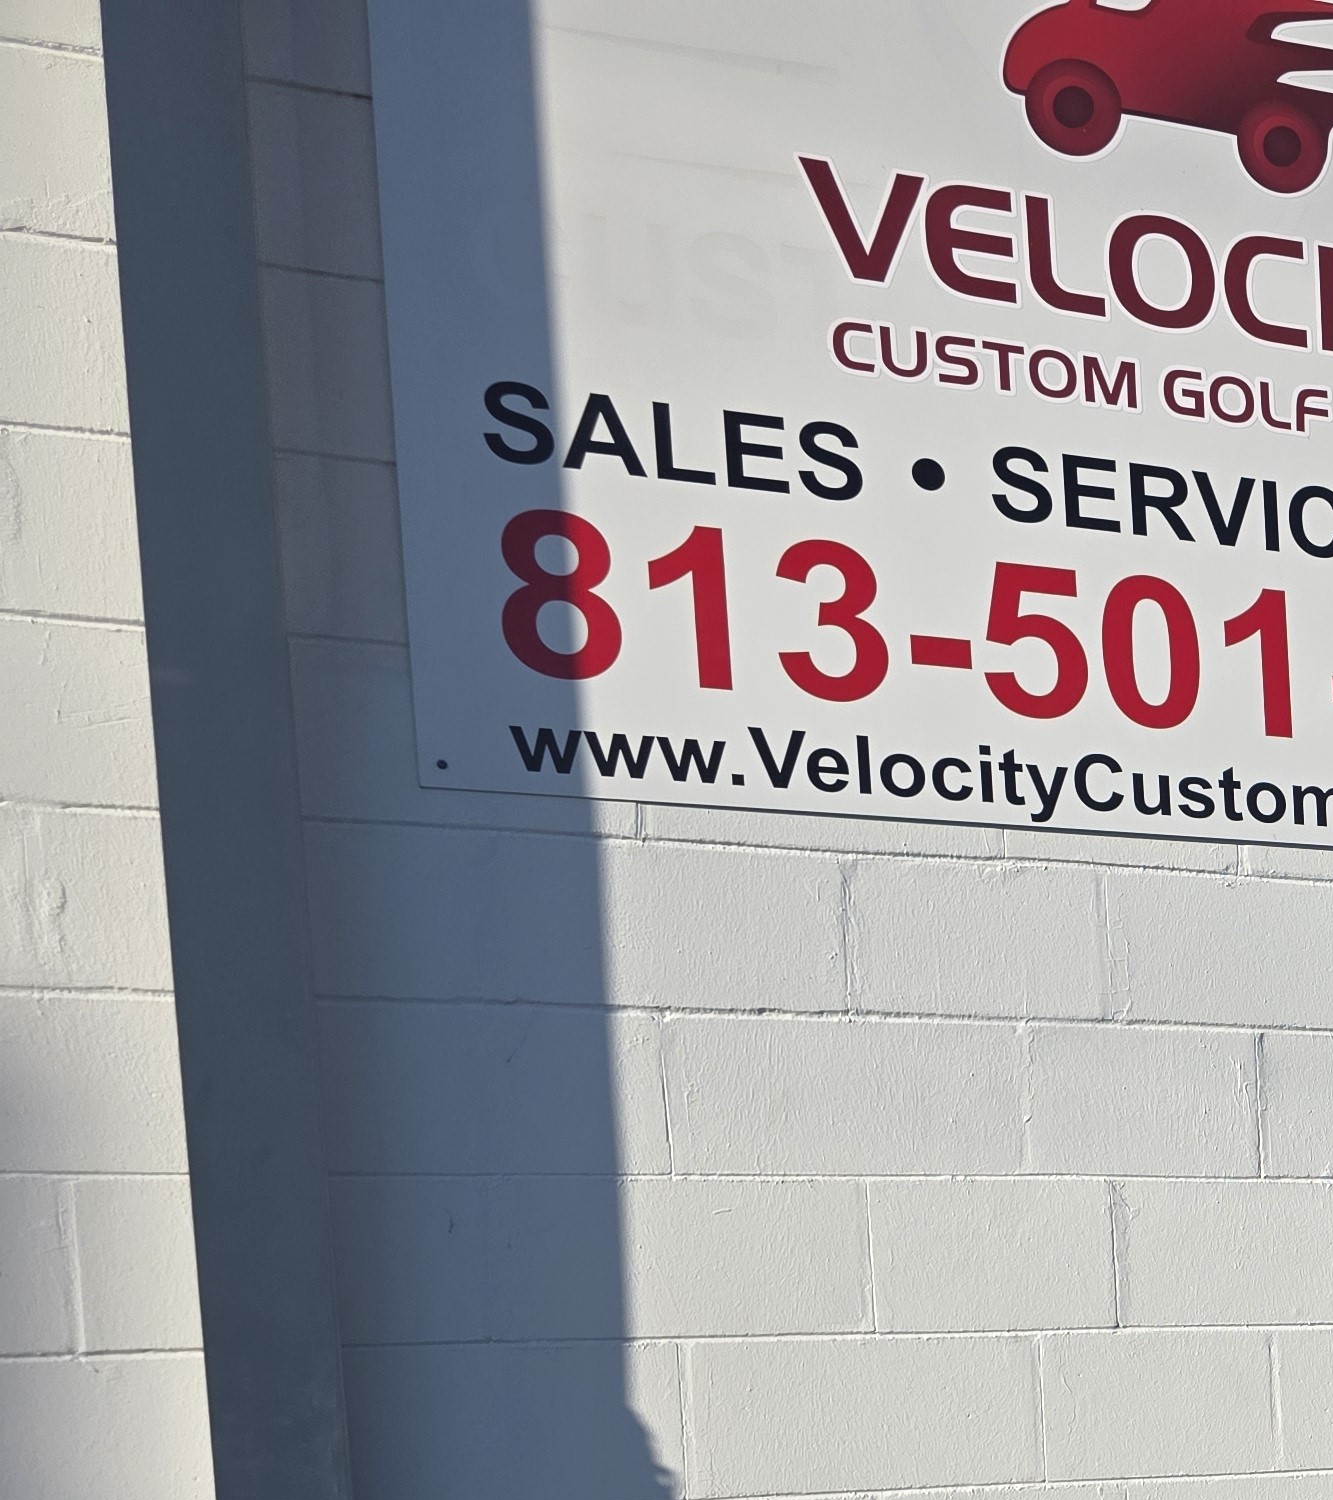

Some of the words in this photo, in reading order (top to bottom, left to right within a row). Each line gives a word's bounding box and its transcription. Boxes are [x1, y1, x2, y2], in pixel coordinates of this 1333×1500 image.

[832, 322, 1138, 408] CUSTOM
[1163, 369, 1331, 432] GOLF
[484, 380, 863, 501] SALES
